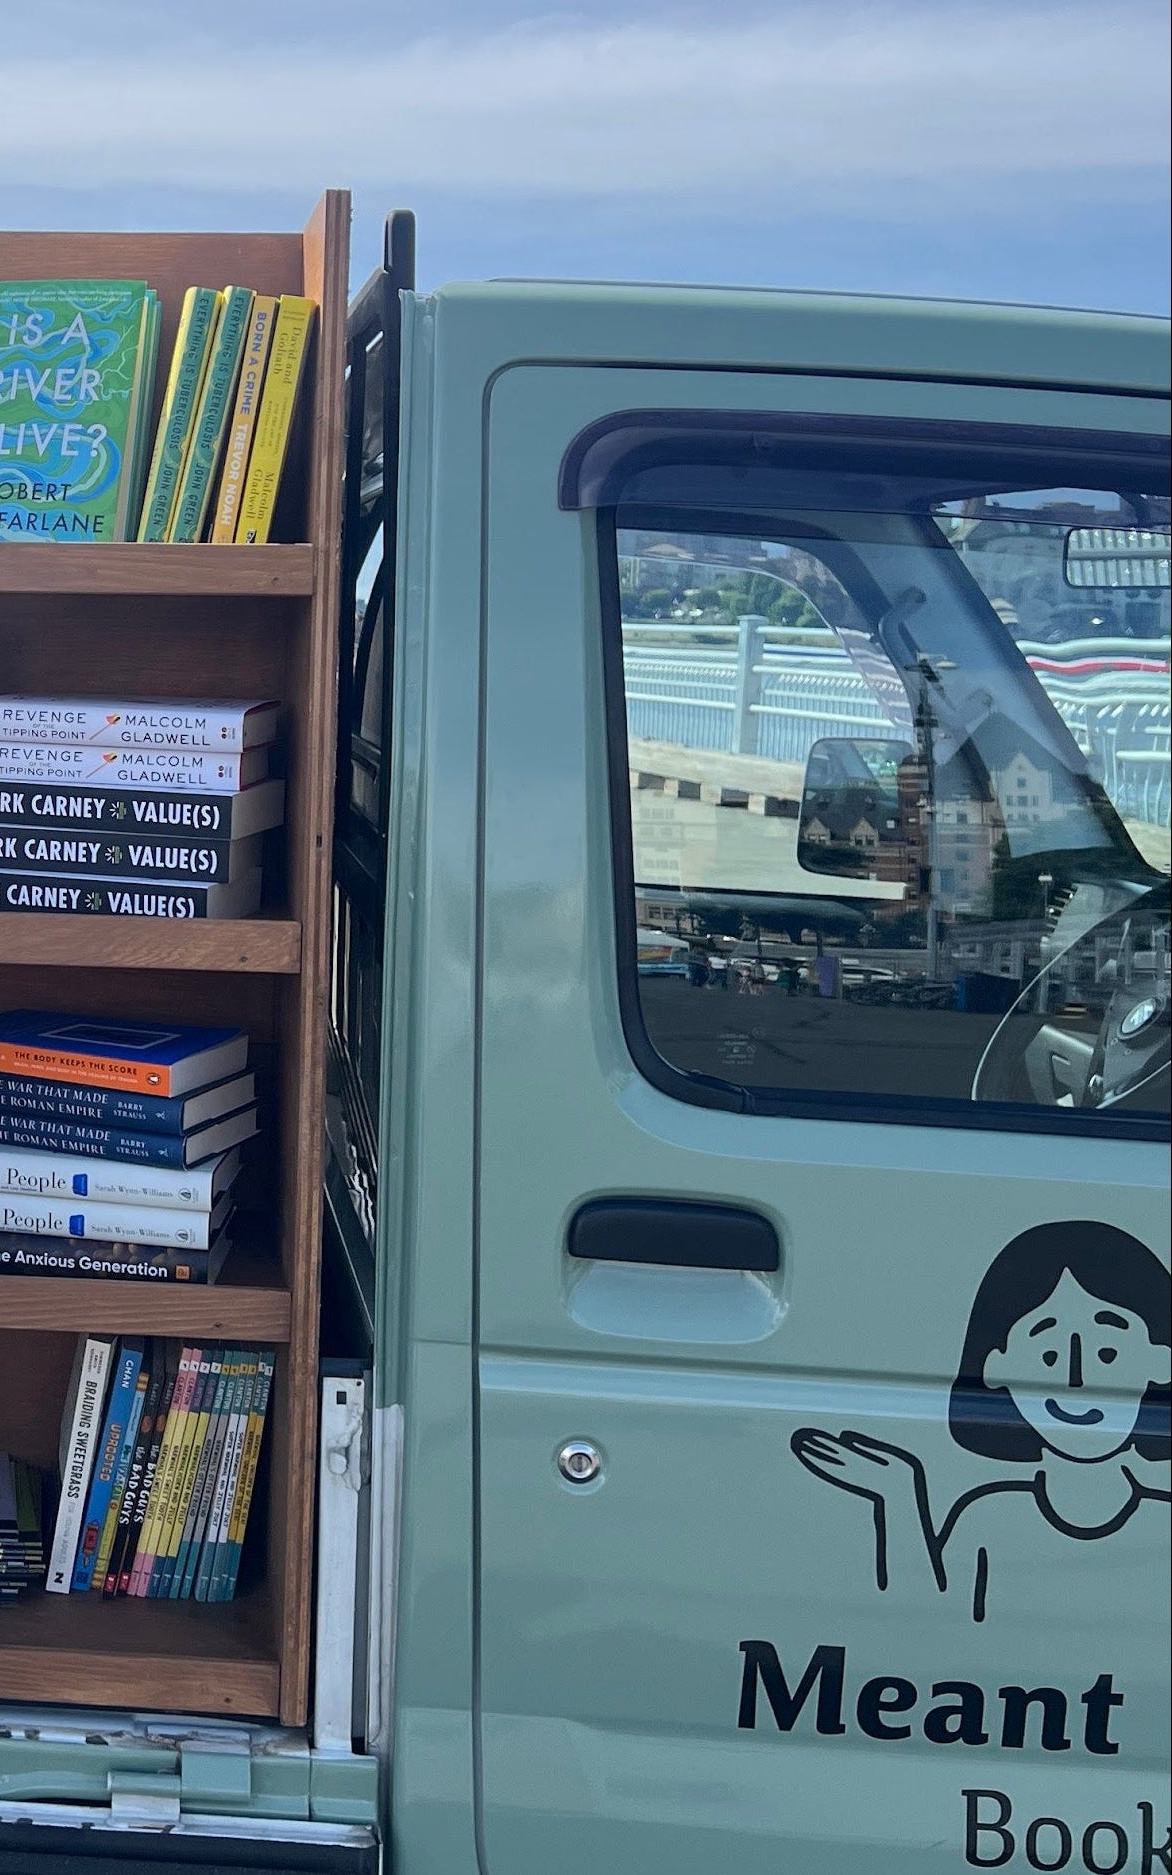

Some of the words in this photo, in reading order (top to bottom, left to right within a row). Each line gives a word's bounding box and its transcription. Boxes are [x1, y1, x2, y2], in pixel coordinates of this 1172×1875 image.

[8, 313, 44, 346] IS
[60, 312, 90, 345] A
[186, 297, 209, 364] EVERYTHING
[255, 311, 267, 350] BORN
[273, 332, 289, 374] Goliath
[291, 327, 302, 361] David
[186, 364, 195, 375] IS
[248, 356, 258, 366] A
[285, 364, 295, 385] and
[241, 373, 256, 415] CRIME
[169, 377, 192, 450] TUBERCULOSIS
[228, 423, 248, 478] TREVOR
[162, 463, 173, 487] JOHN
[220, 482, 235, 526] NOAH
[246, 469, 262, 520] Gladwell
[257, 471, 274, 522] Malcolm
[153, 493, 168, 526] GREEN
[3, 709, 87, 724] REVENGE
[125, 714, 206, 729] MALCOLM
[2, 728, 47, 739] TIPPING
[51, 729, 86, 740] POINT
[121, 732, 210, 746] GLADWELL
[0, 748, 83, 763] REVENGE
[122, 753, 203, 768] MALCOLM
[0, 766, 44, 777] TIPPING
[47, 767, 82, 778] POINT
[117, 770, 206, 785] GLADWELL
[31, 794, 106, 819] CARNEY
[132, 801, 220, 829] VALUE(S)
[24, 839, 101, 864] CARNEY
[129, 845, 217, 874] VALUE(S)
[6, 884, 81, 910] CARNEY
[107, 891, 195, 918] VALUE(S)
[14, 1051, 30, 1061] THE
[34, 1052, 56, 1063] BODY
[60, 1056, 85, 1068] KEEPS
[89, 1060, 105, 1071] THE
[109, 1063, 137, 1075] SCORE
[7, 1080, 32, 1093] WAR
[37, 1084, 69, 1098] THAT
[73, 1089, 108, 1104] MADE
[117, 1101, 143, 1111] BARRY
[10, 1096, 54, 1112] ROMAN
[58, 1104, 103, 1119] EMPIRE
[113, 1109, 147, 1120] STRAUSS
[7, 1167, 67, 1192] People
[94, 1183, 116, 1193] Sarah
[118, 1186, 174, 1199] Wynn-Williams
[14, 1250, 75, 1269] Anxious
[78, 1256, 168, 1279] Generation
[121, 1360, 134, 1389] CHAN
[78, 1380, 98, 1429] BRAIDING
[67, 1430, 89, 1500] SWEETGRASS
[99, 1424, 122, 1482] UPROOTED
[128, 1464, 142, 1490] BAD
[119, 1490, 136, 1526] GUYS
[738, 1640, 1124, 1755] Meant
